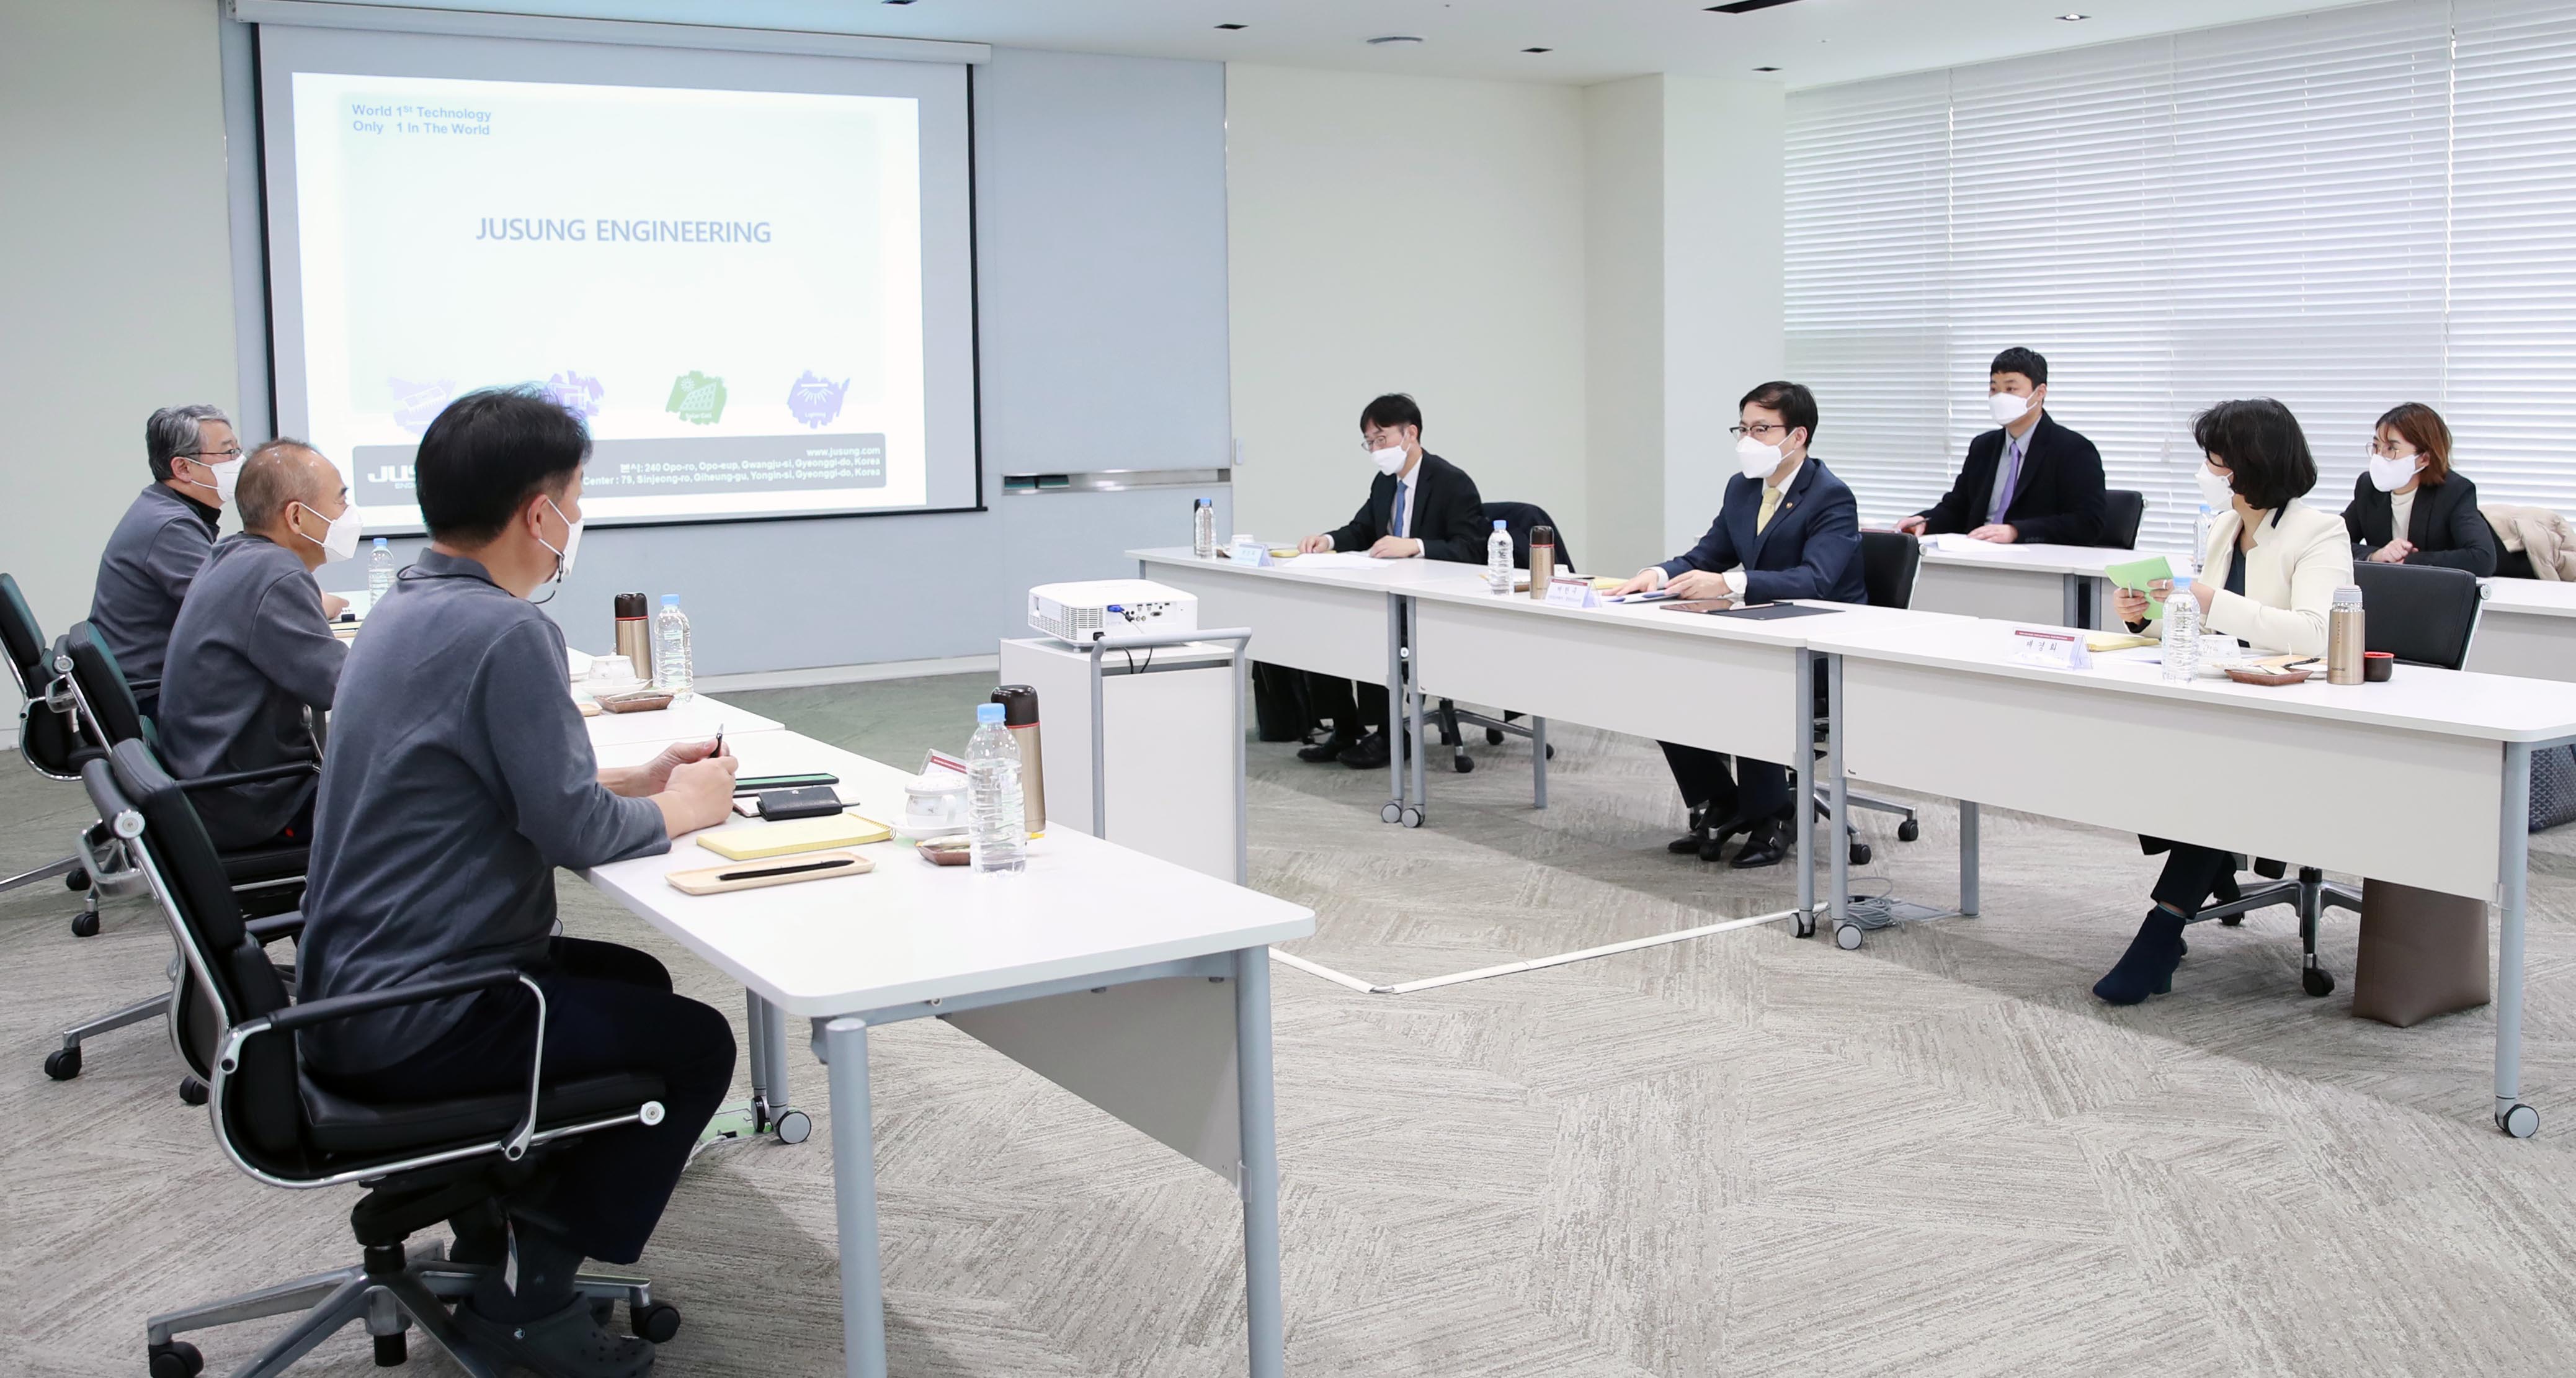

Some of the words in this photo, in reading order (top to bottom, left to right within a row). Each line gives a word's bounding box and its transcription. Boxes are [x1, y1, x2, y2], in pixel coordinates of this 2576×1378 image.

[352, 104, 392, 117] World
[417, 107, 491, 122] Technology
[353, 120, 383, 135] Only
[397, 122, 403, 133] 1
[408, 123, 419, 133] In
[424, 123, 448, 134] The
[452, 123, 489, 135] World
[476, 218, 586, 241] JUSUNG
[596, 219, 772, 243] ENGINEERING
[806, 447, 881, 458] www.jusung.com
[644, 463, 661, 472] 240
[662, 462, 697, 473] Opo-ro,
[698, 461, 741, 472] Opo-eup,
[741, 459, 794, 470] Gwangju-si,
[795, 458, 853, 468] Gyeonggi-do,
[854, 457, 881, 466] Korea
[583, 476, 614, 486] Center
[636, 473, 693, 485] Sinjeong-ro,
[693, 472, 749, 483] Giheung-gu,
[750, 470, 795, 481] Yongin-si,
[795, 468, 853, 480] Gyeonggi-do,
[855, 467, 881, 477] Korea
